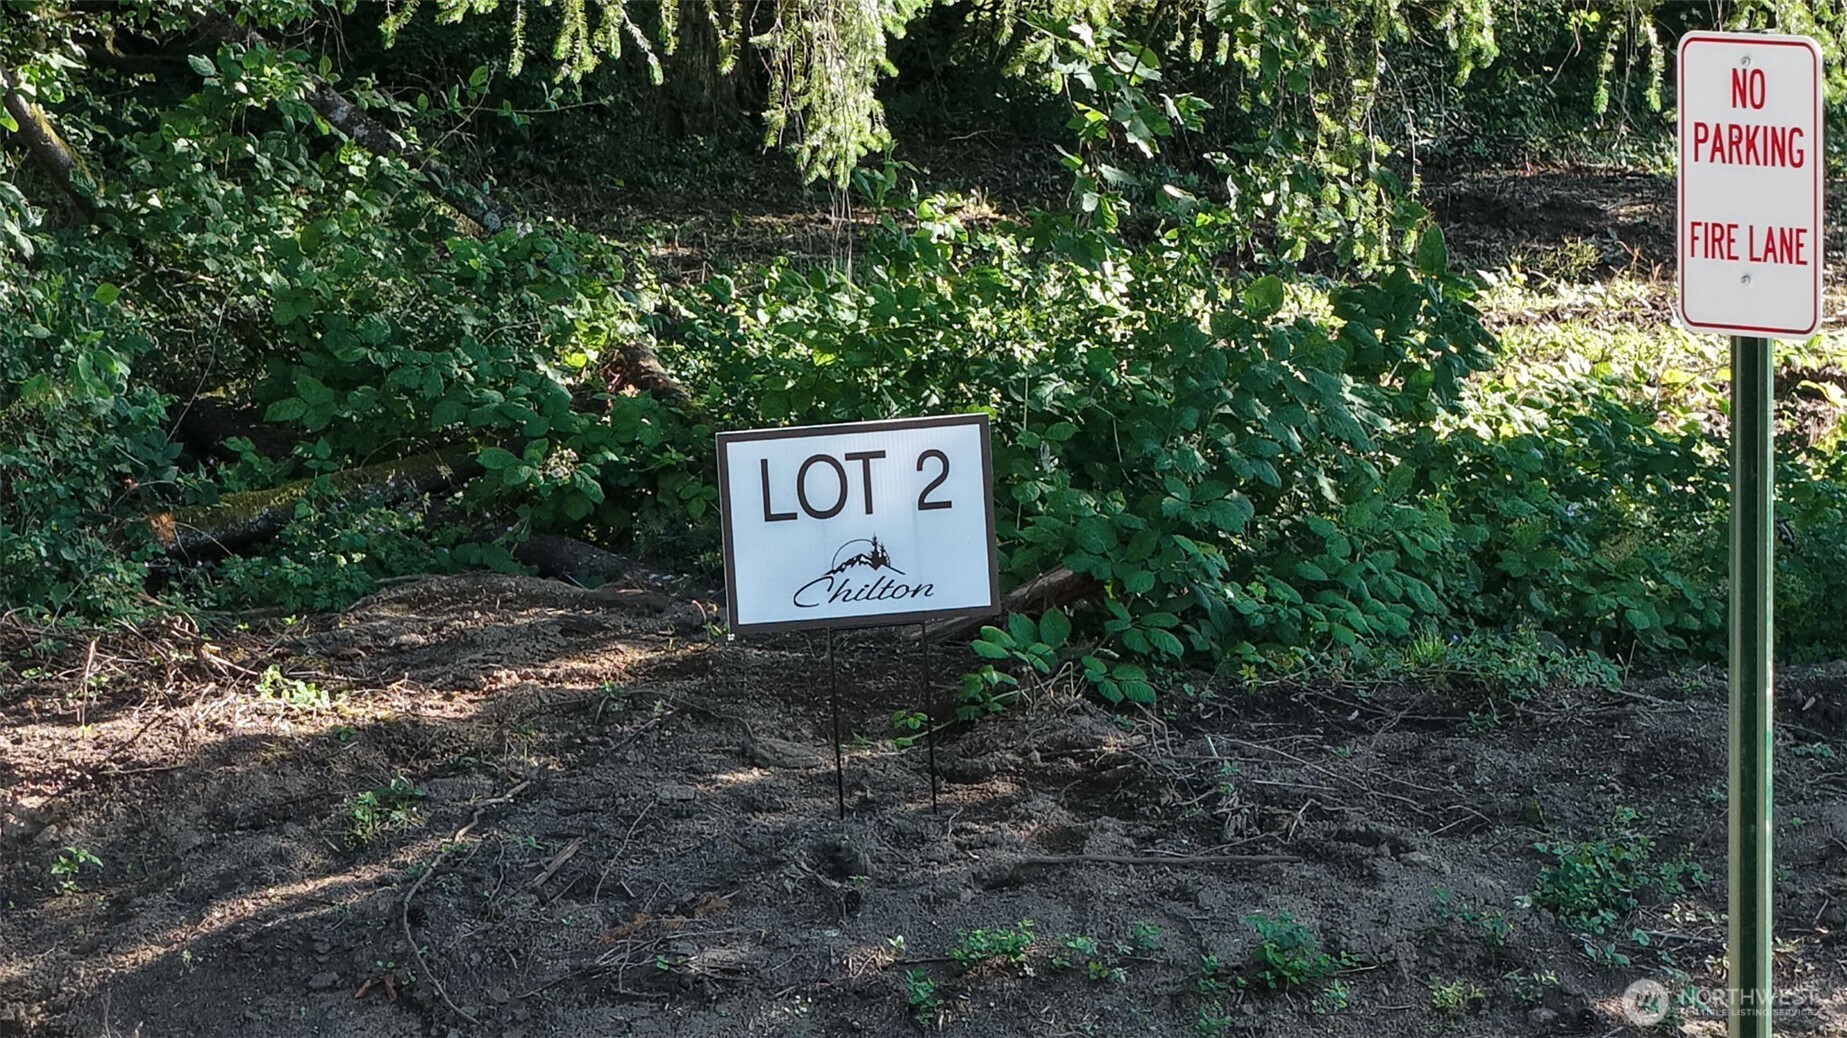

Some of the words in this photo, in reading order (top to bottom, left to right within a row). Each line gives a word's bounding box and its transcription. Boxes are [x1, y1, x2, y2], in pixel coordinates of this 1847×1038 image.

[1731, 68, 1766, 110] NO
[1694, 122, 1804, 168] PARKING
[1690, 221, 1739, 261] FIRE
[1749, 225, 1808, 265] LANE
[760, 450, 886, 522] LOT
[916, 449, 952, 510] 2
[793, 575, 934, 607] Chilton
